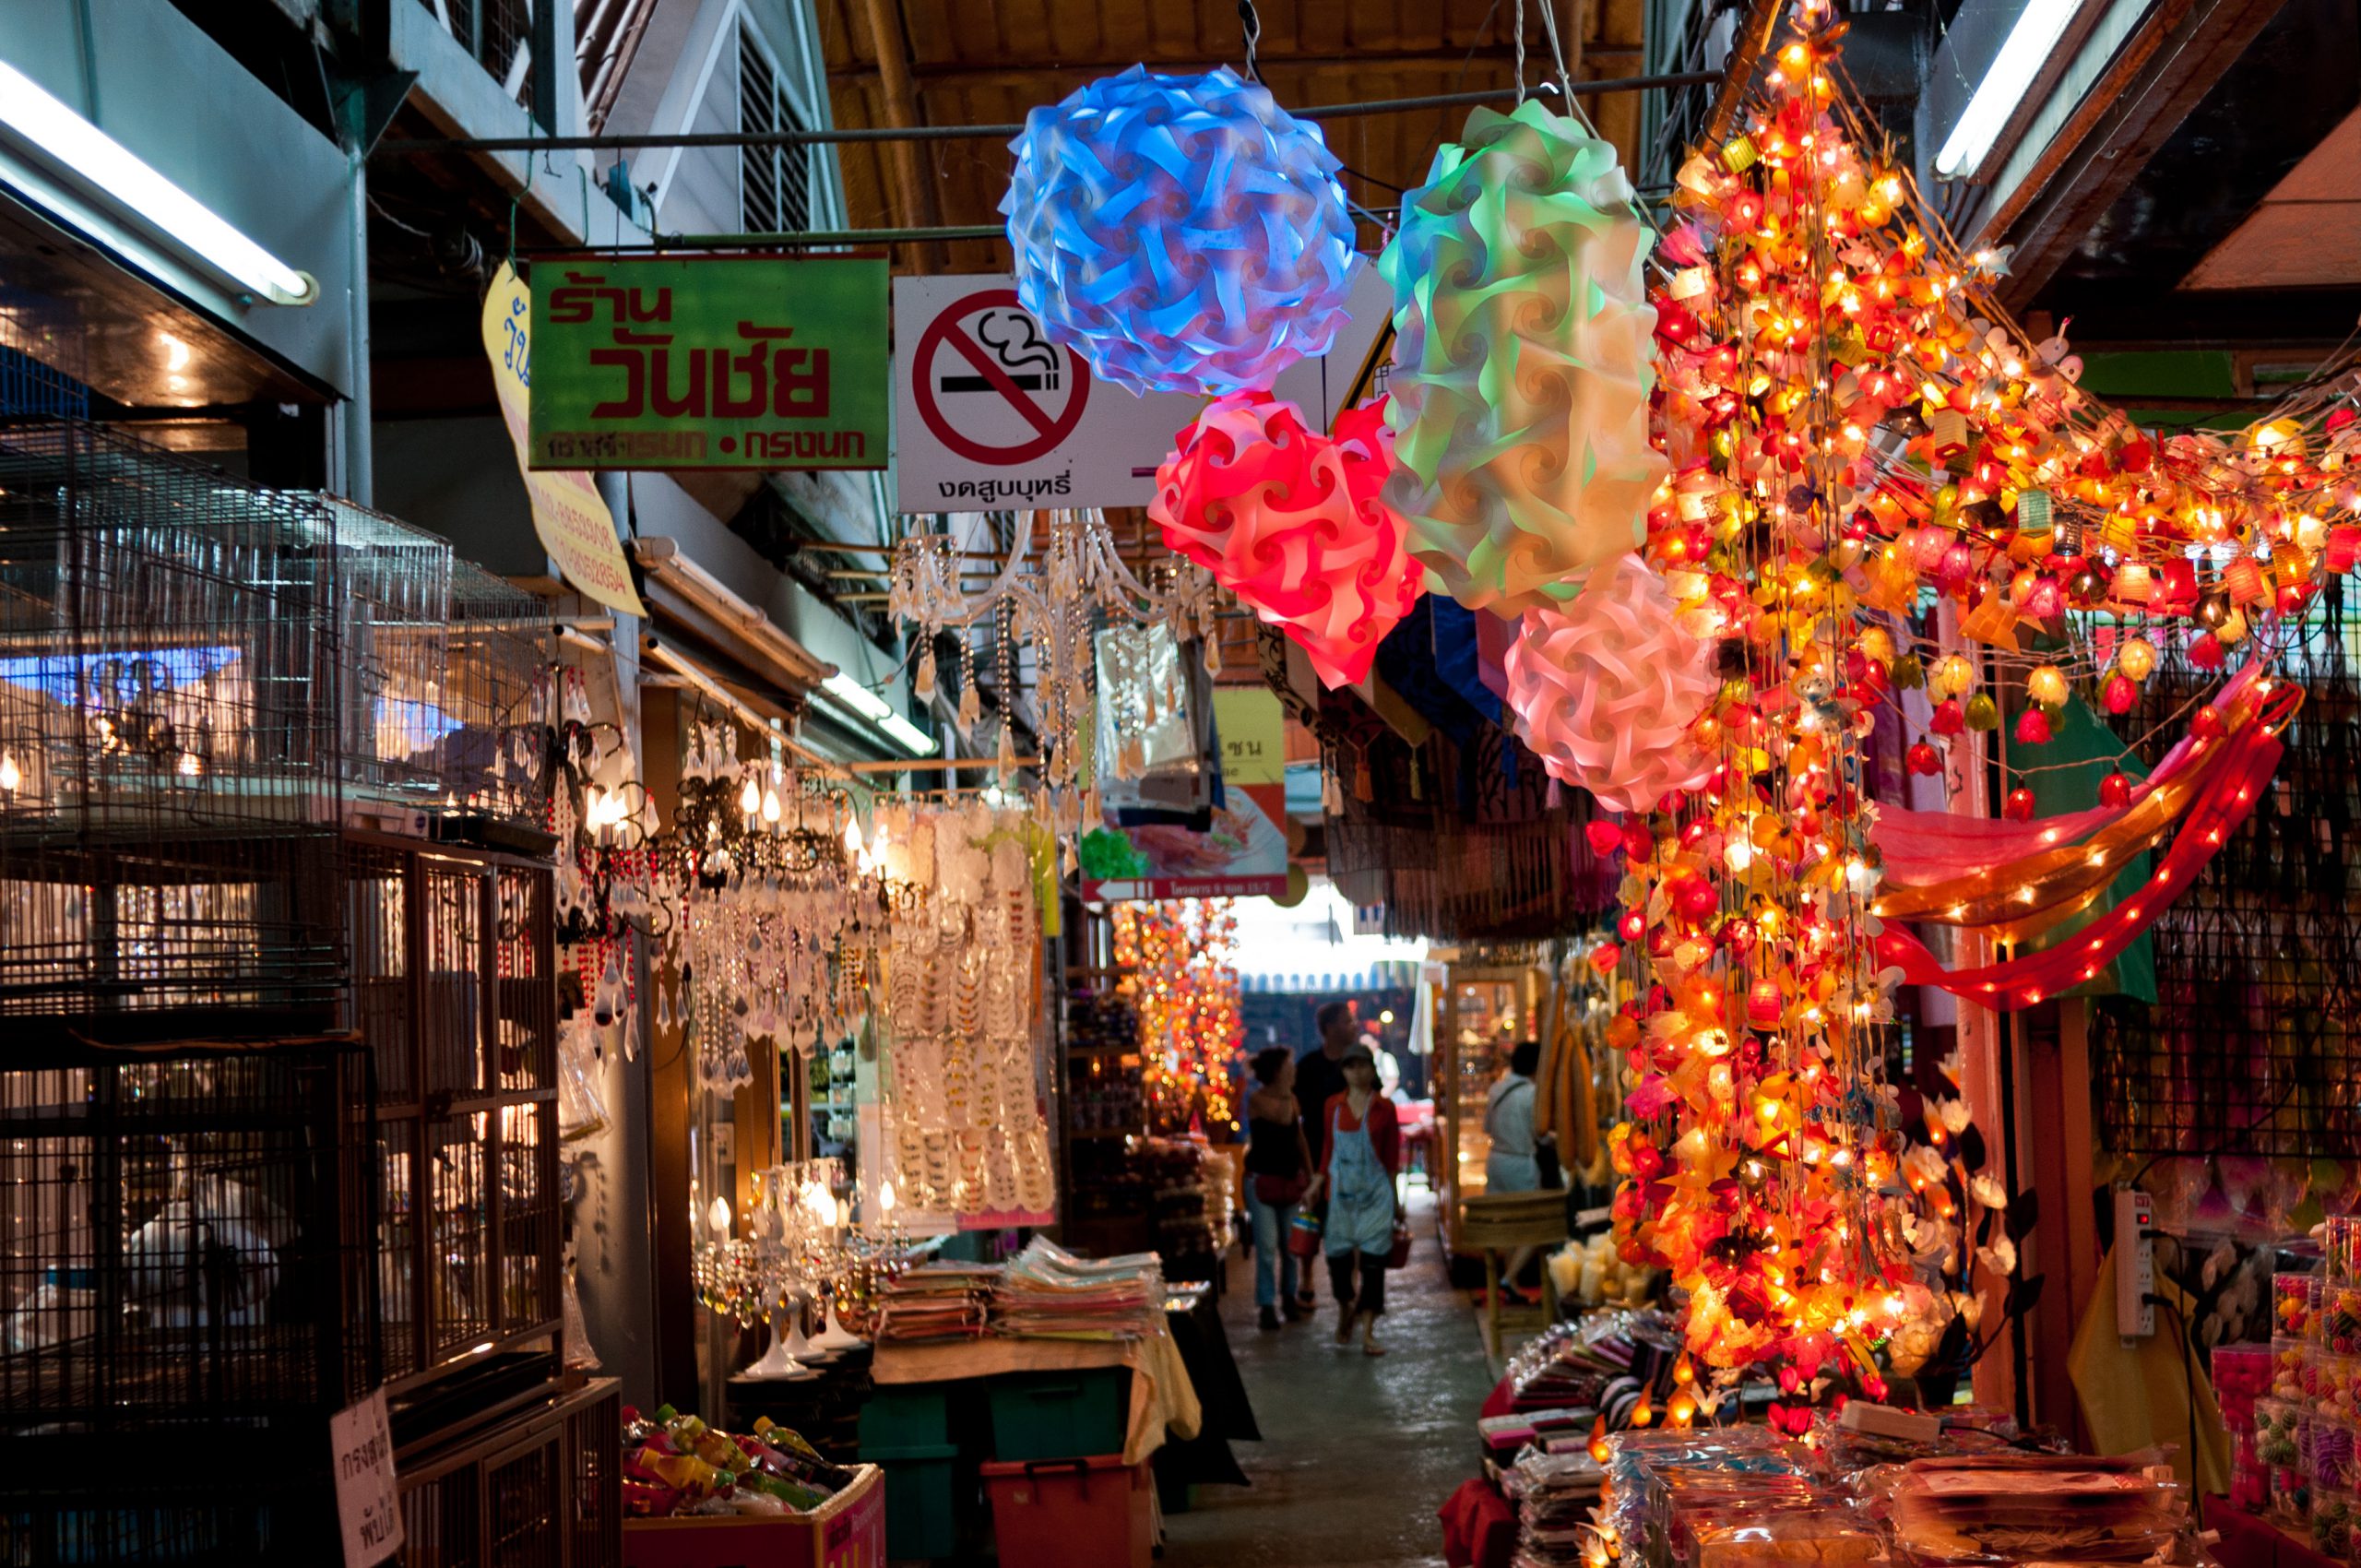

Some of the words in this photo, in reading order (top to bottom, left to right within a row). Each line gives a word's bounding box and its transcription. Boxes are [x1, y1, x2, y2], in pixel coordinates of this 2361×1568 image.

[549, 271, 672, 323] ร้าน
[589, 321, 830, 419] วันชัย
[745, 431, 865, 459] กรงนก
[938, 469, 1072, 504] งดสูบบุหรี่
